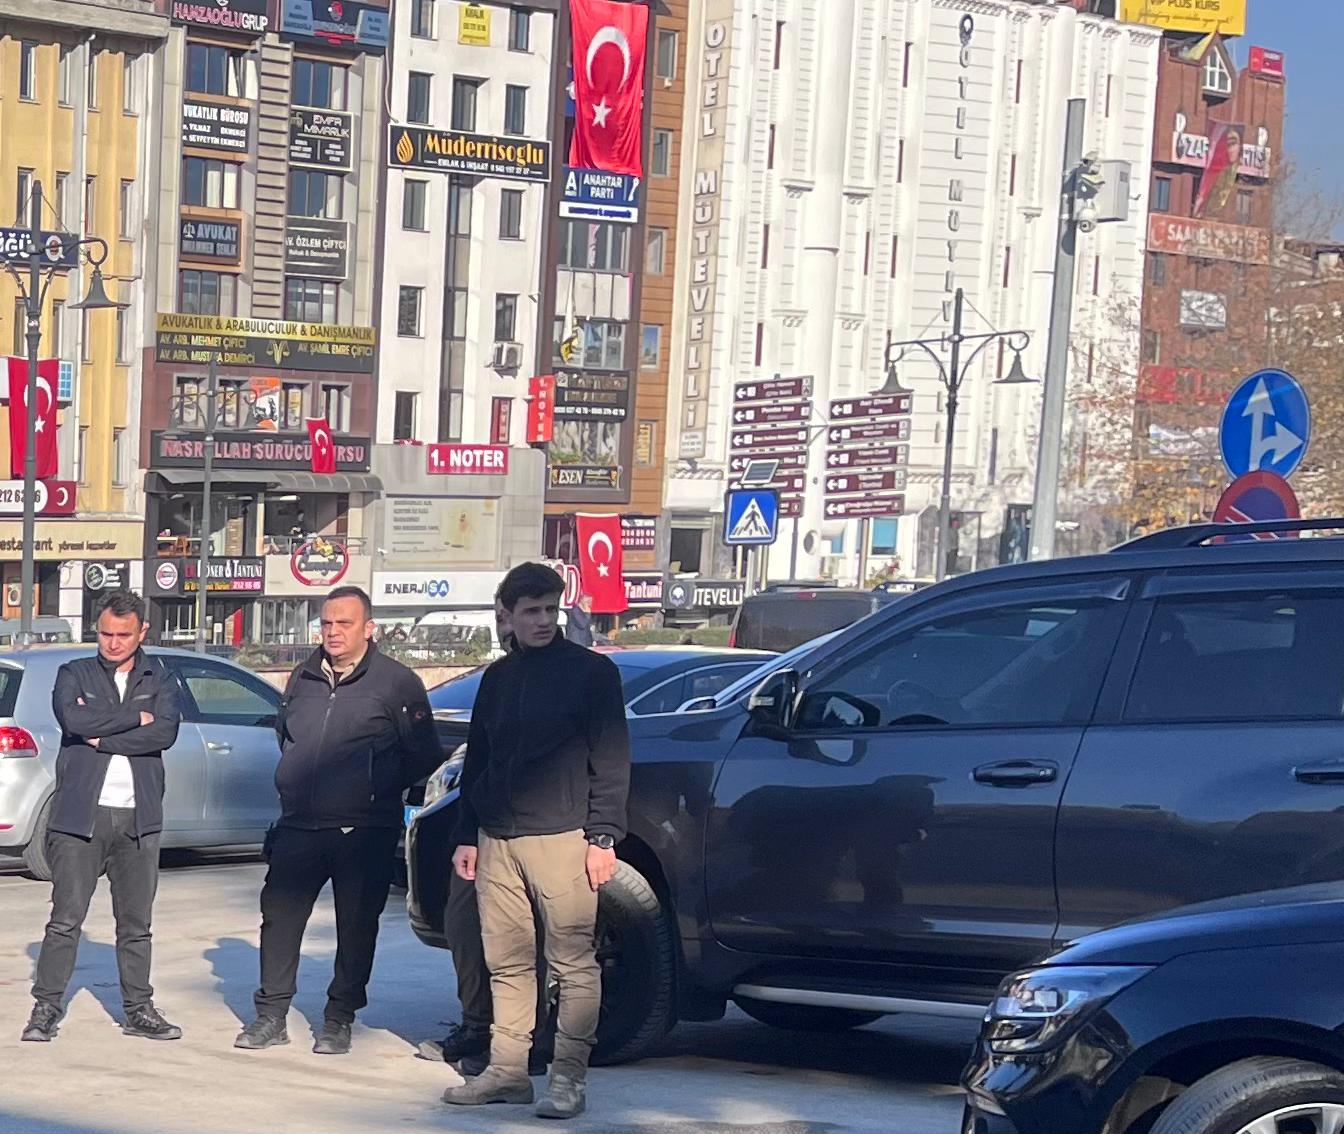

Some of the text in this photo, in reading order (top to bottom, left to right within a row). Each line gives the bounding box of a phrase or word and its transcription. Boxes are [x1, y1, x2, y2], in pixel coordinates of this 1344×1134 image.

[702, 23, 726, 137] OTEL
[196, 223, 238, 242] AVUKAT
[161, 314, 212, 329] AVUKATLIK
[160, 439, 252, 460] NASRLLAH
[430, 448, 505, 468] 1. NOTER
